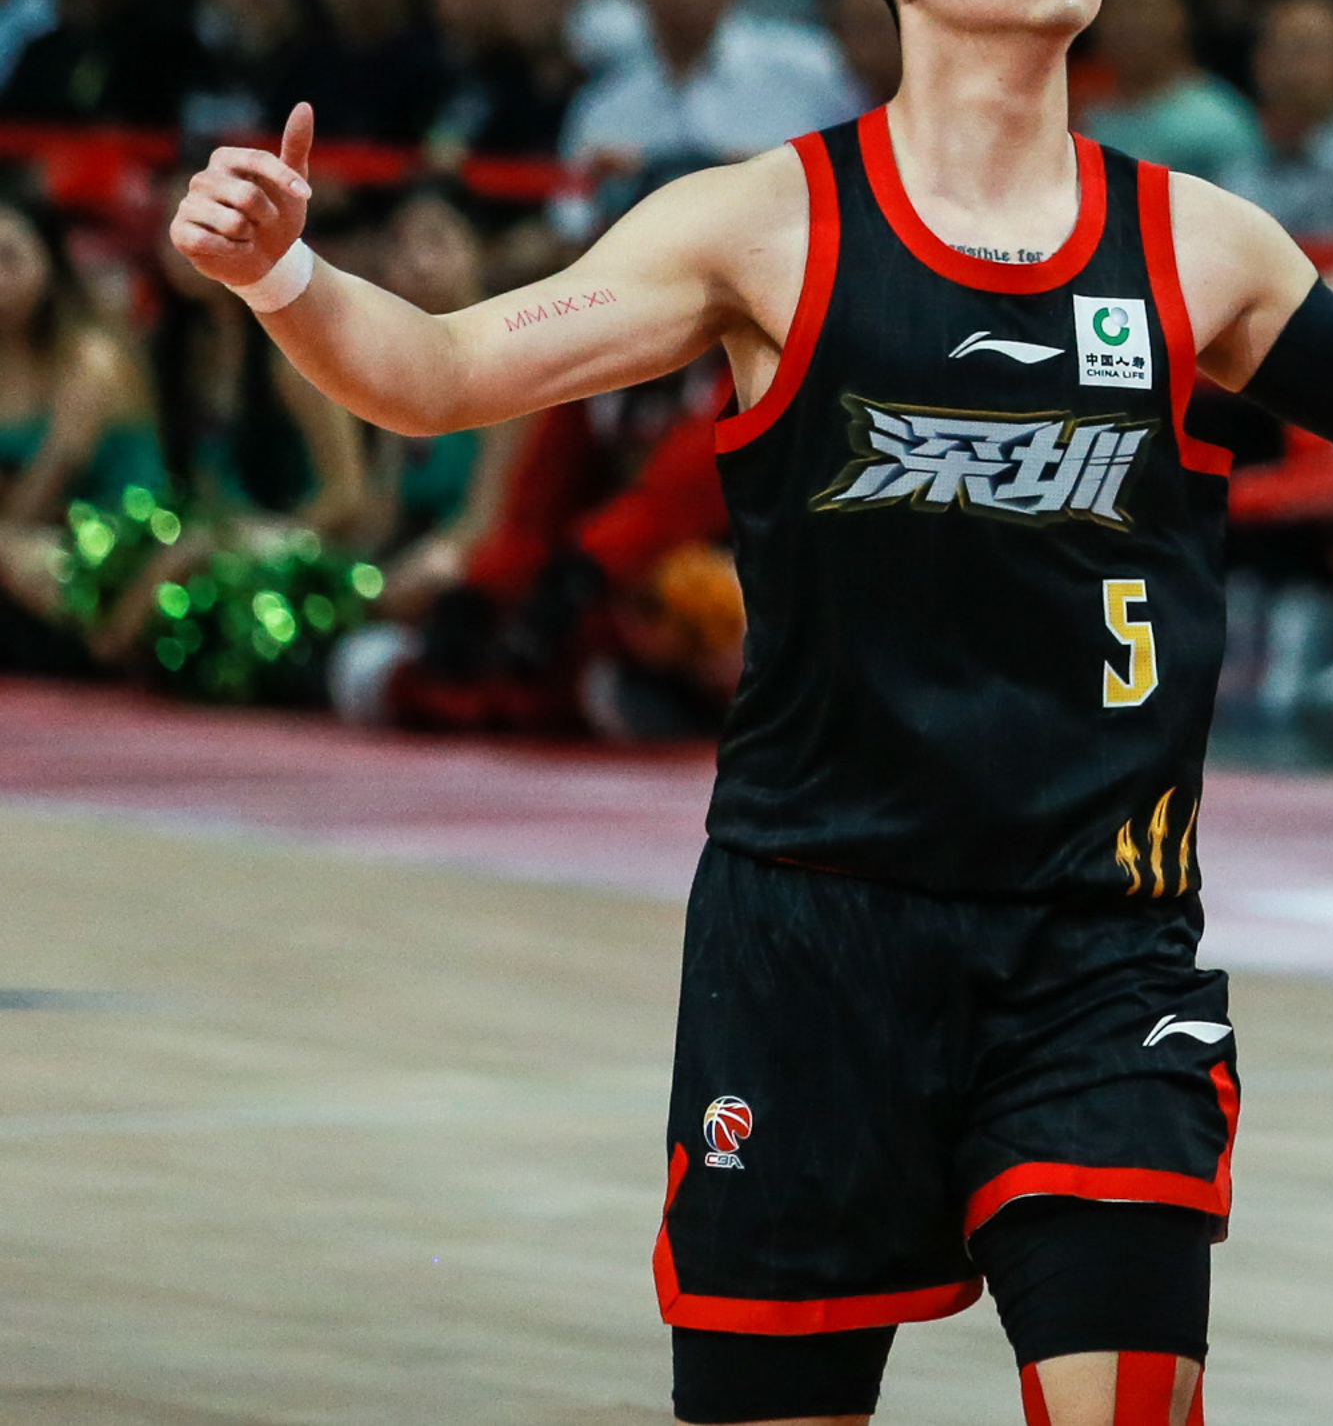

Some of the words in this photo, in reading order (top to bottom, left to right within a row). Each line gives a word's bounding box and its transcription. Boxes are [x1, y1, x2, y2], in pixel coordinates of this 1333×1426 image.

[1018, 249, 1043, 263] for
[1086, 353, 1145, 369] 中国人寿
[1087, 369, 1119, 377] CHINA
[1123, 371, 1144, 379] LIFE
[832, 407, 1150, 521] 深圳
[1102, 578, 1160, 709] 5
[706, 1153, 745, 1169] CBA
